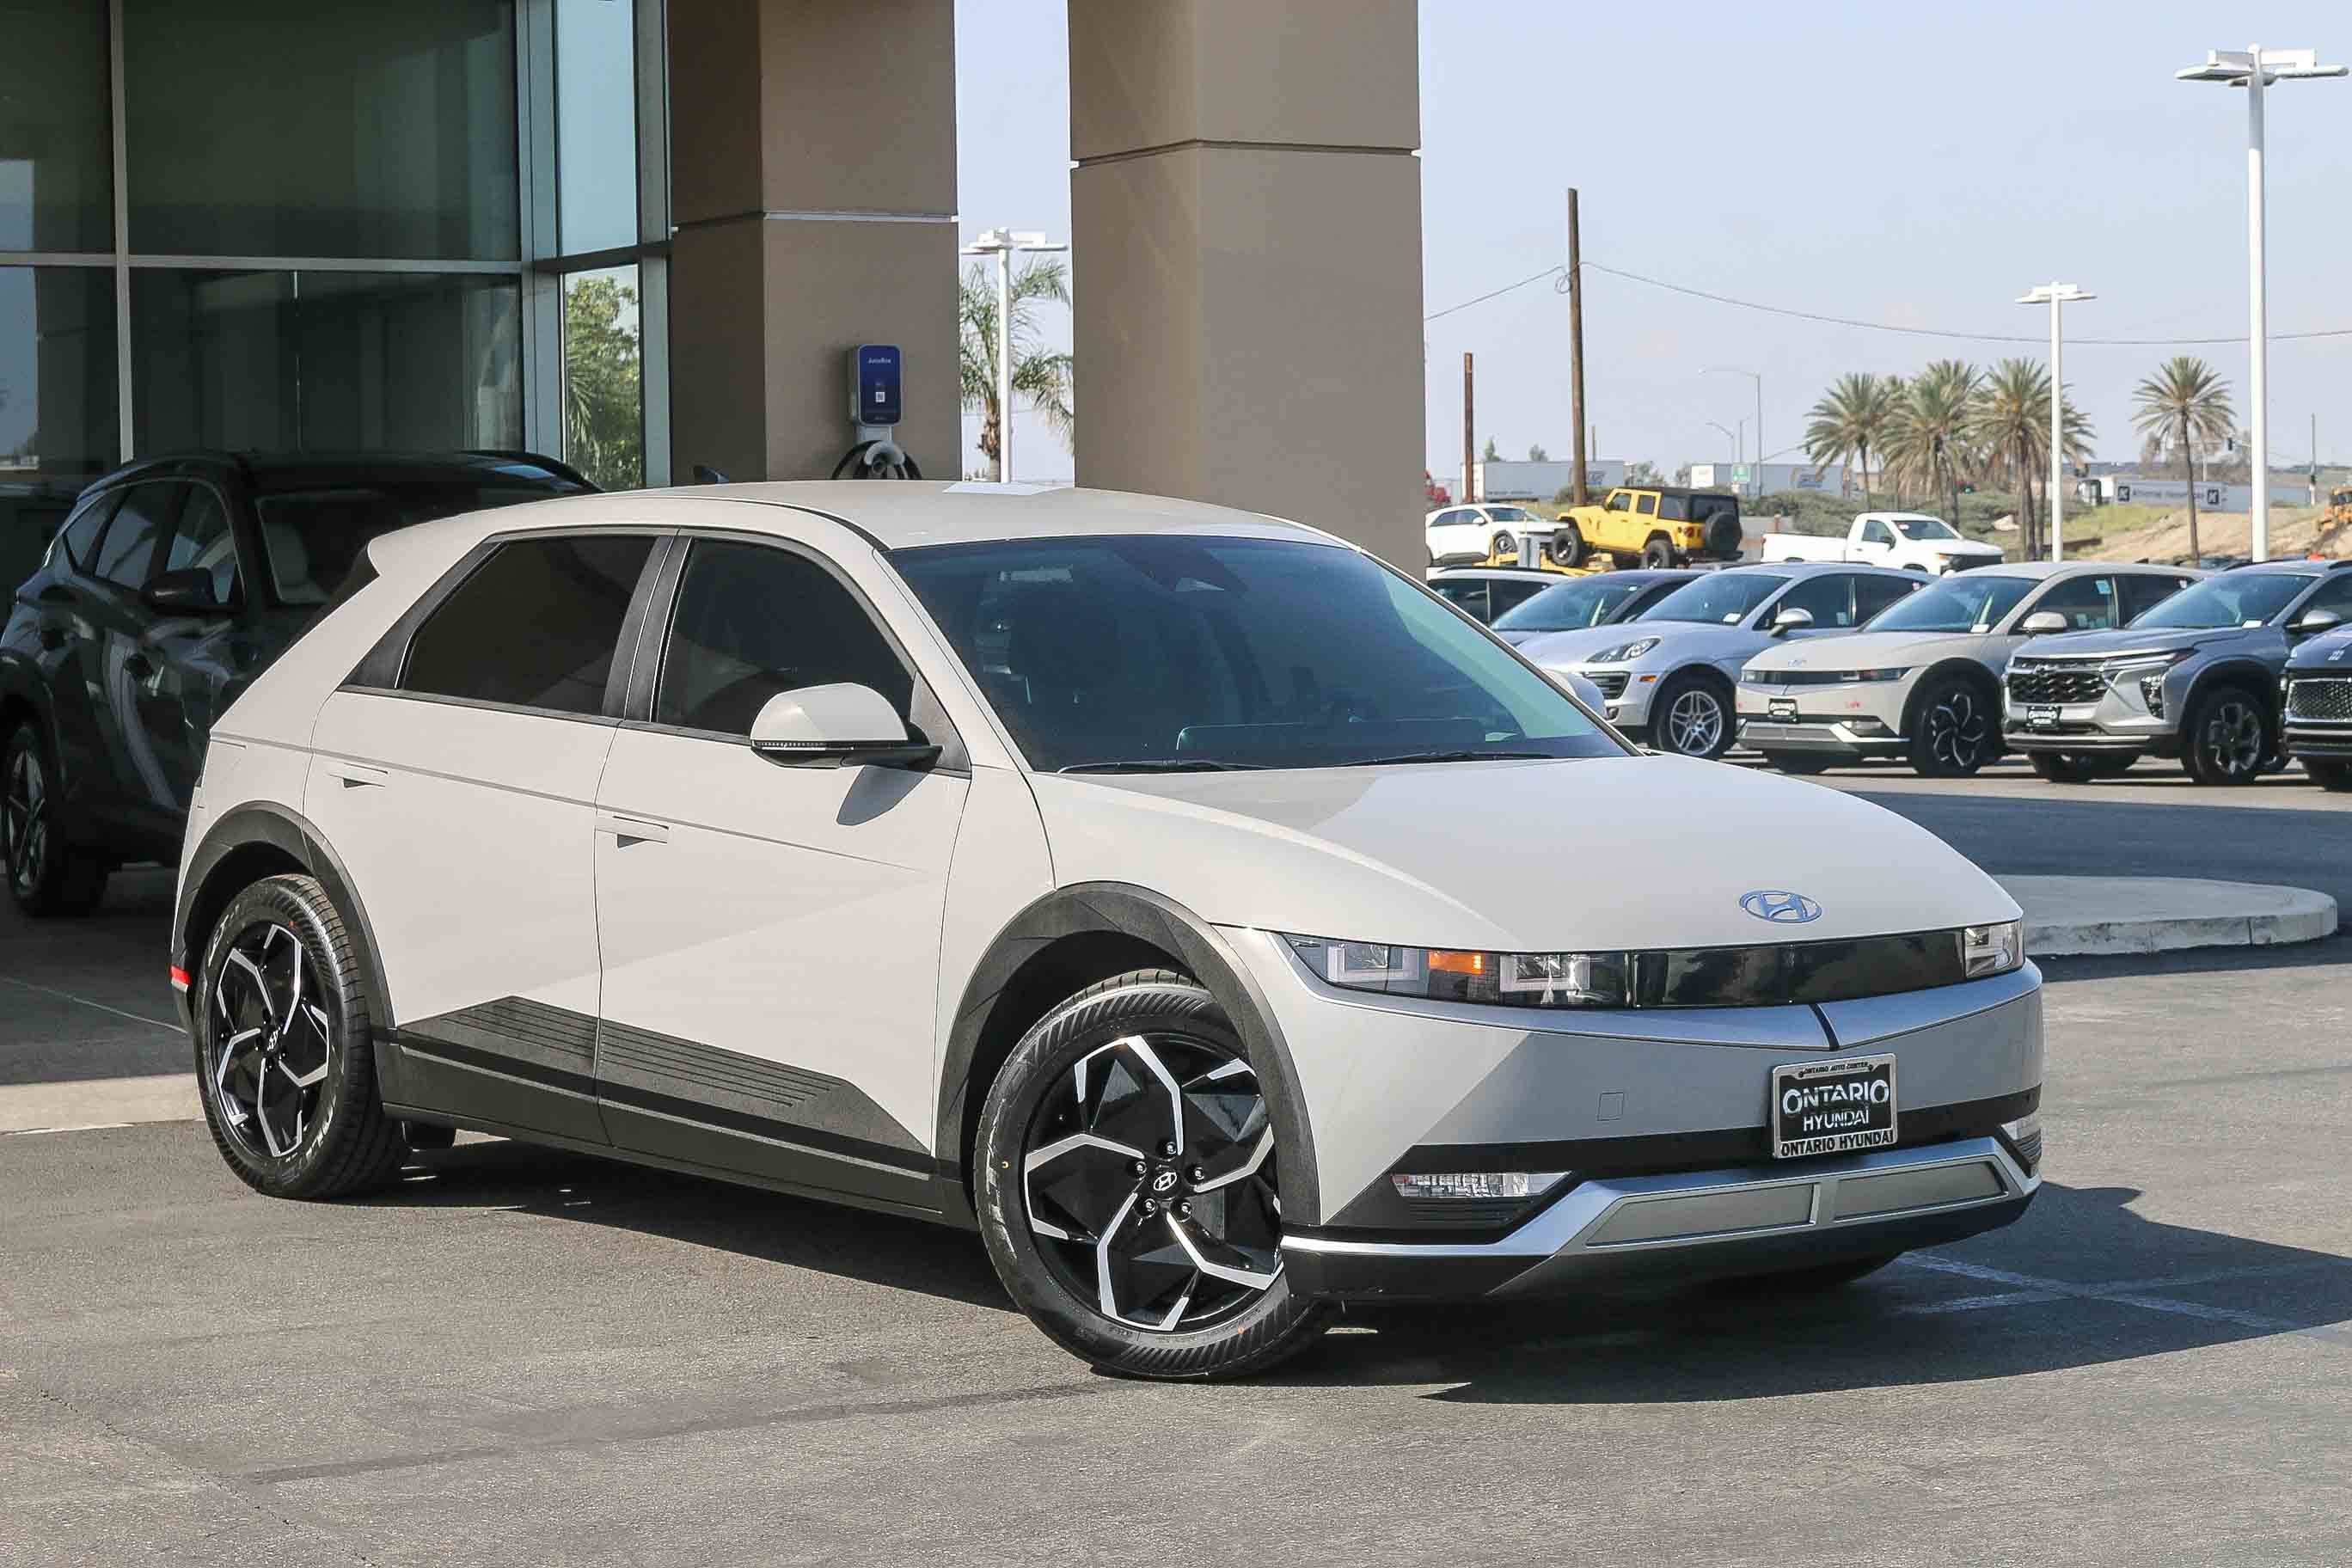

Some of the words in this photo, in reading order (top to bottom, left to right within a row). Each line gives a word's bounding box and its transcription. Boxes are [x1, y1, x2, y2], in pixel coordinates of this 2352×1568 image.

[1830, 1063, 1845, 1072] AUTO
[1782, 1079, 1890, 1114] ONTARIO
[1804, 1108, 1869, 1131] HYUNDAI
[1781, 1136, 1835, 1156] ONTARIO
[1839, 1130, 1893, 1149] HYUNDAI
